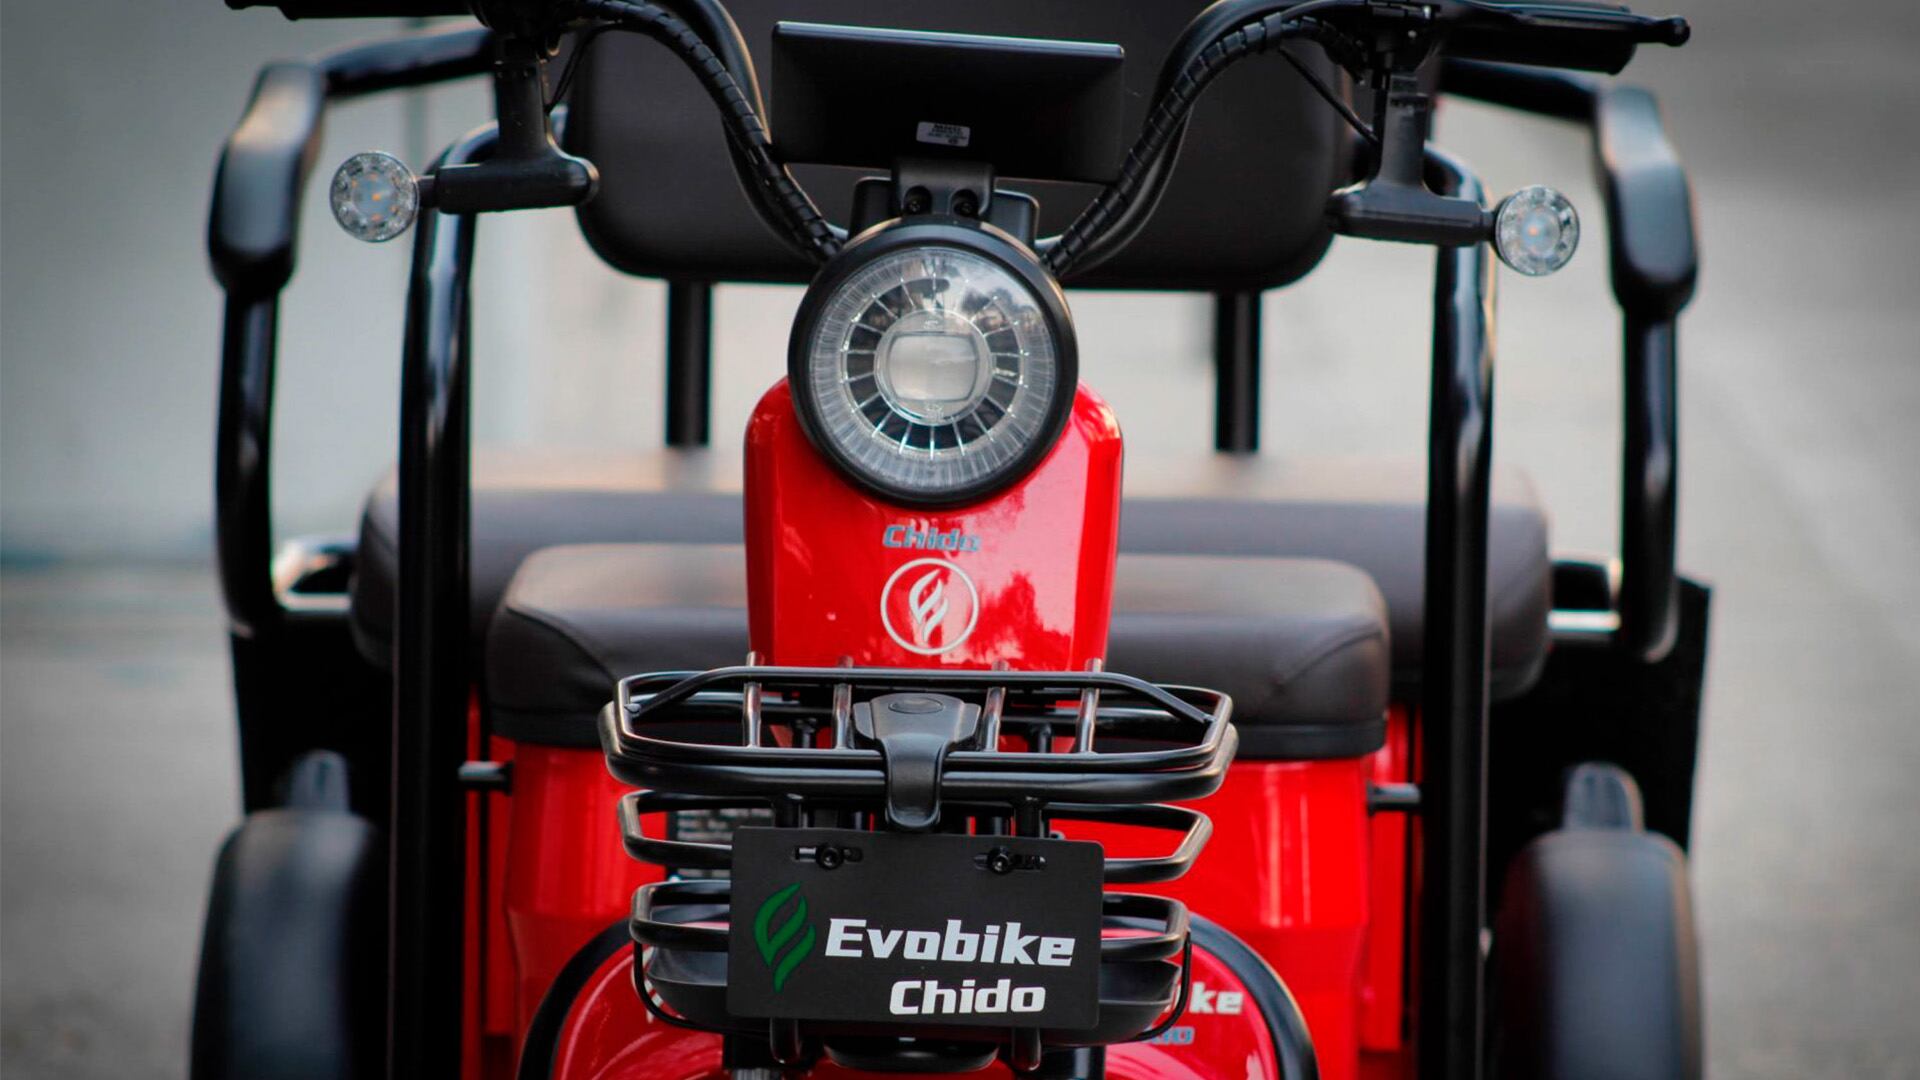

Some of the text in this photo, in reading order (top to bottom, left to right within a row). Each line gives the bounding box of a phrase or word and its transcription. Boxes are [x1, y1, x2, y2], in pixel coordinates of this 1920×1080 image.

[883, 525, 981, 551] Chido
[825, 919, 1076, 966] Evobike
[889, 979, 1047, 1015] Chido
